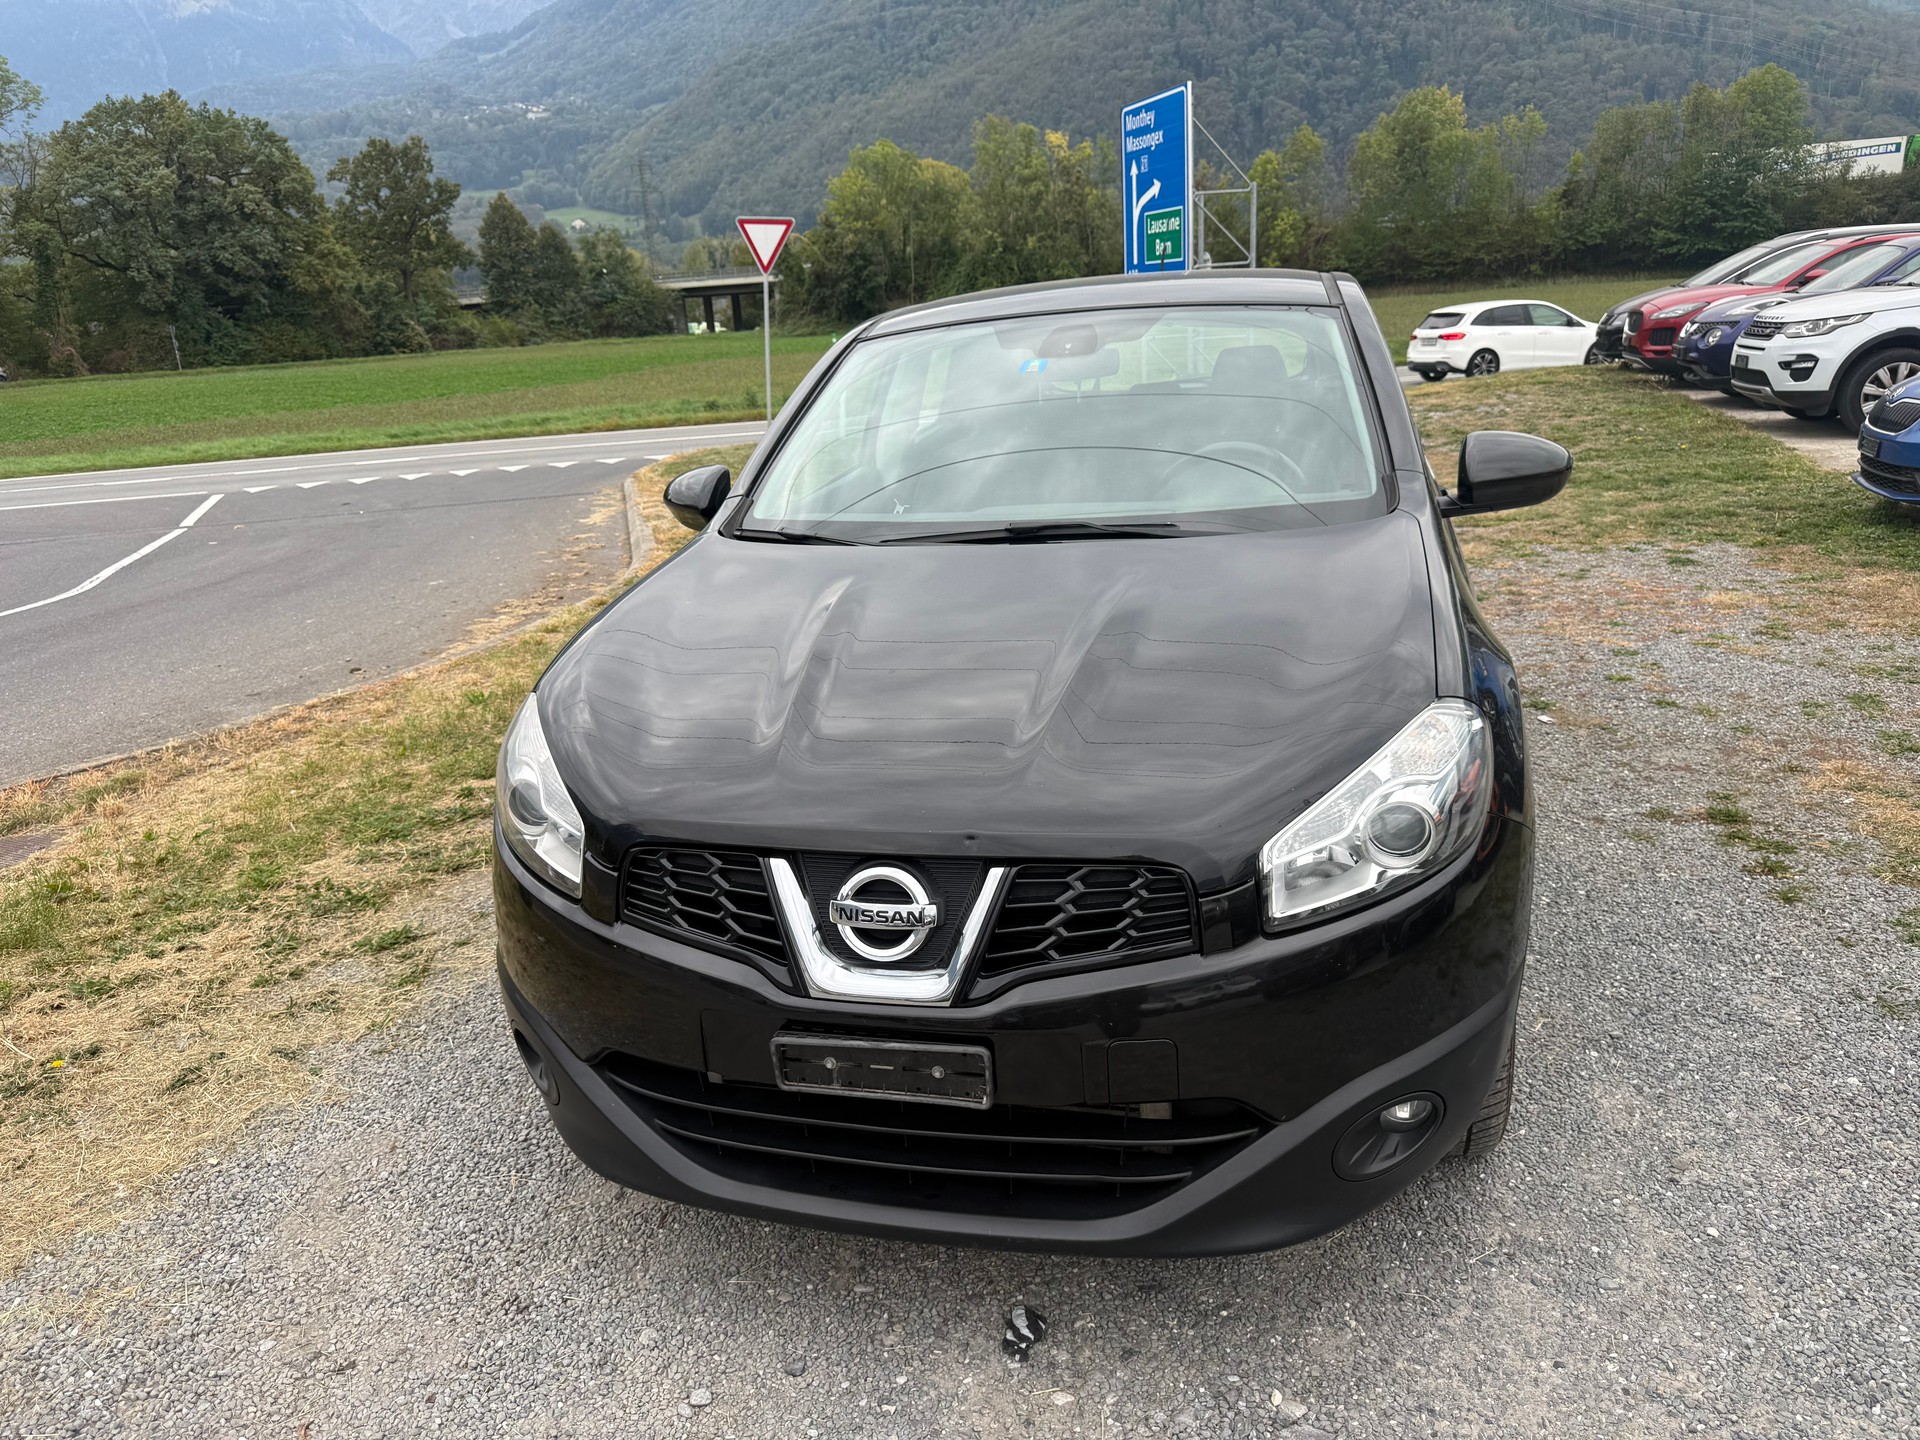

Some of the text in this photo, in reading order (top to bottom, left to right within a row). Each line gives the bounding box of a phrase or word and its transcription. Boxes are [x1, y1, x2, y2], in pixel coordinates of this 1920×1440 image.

[1126, 109, 1155, 131] Monthey
[1126, 130, 1163, 153] Massongex
[839, 907, 923, 925] NISSAN
